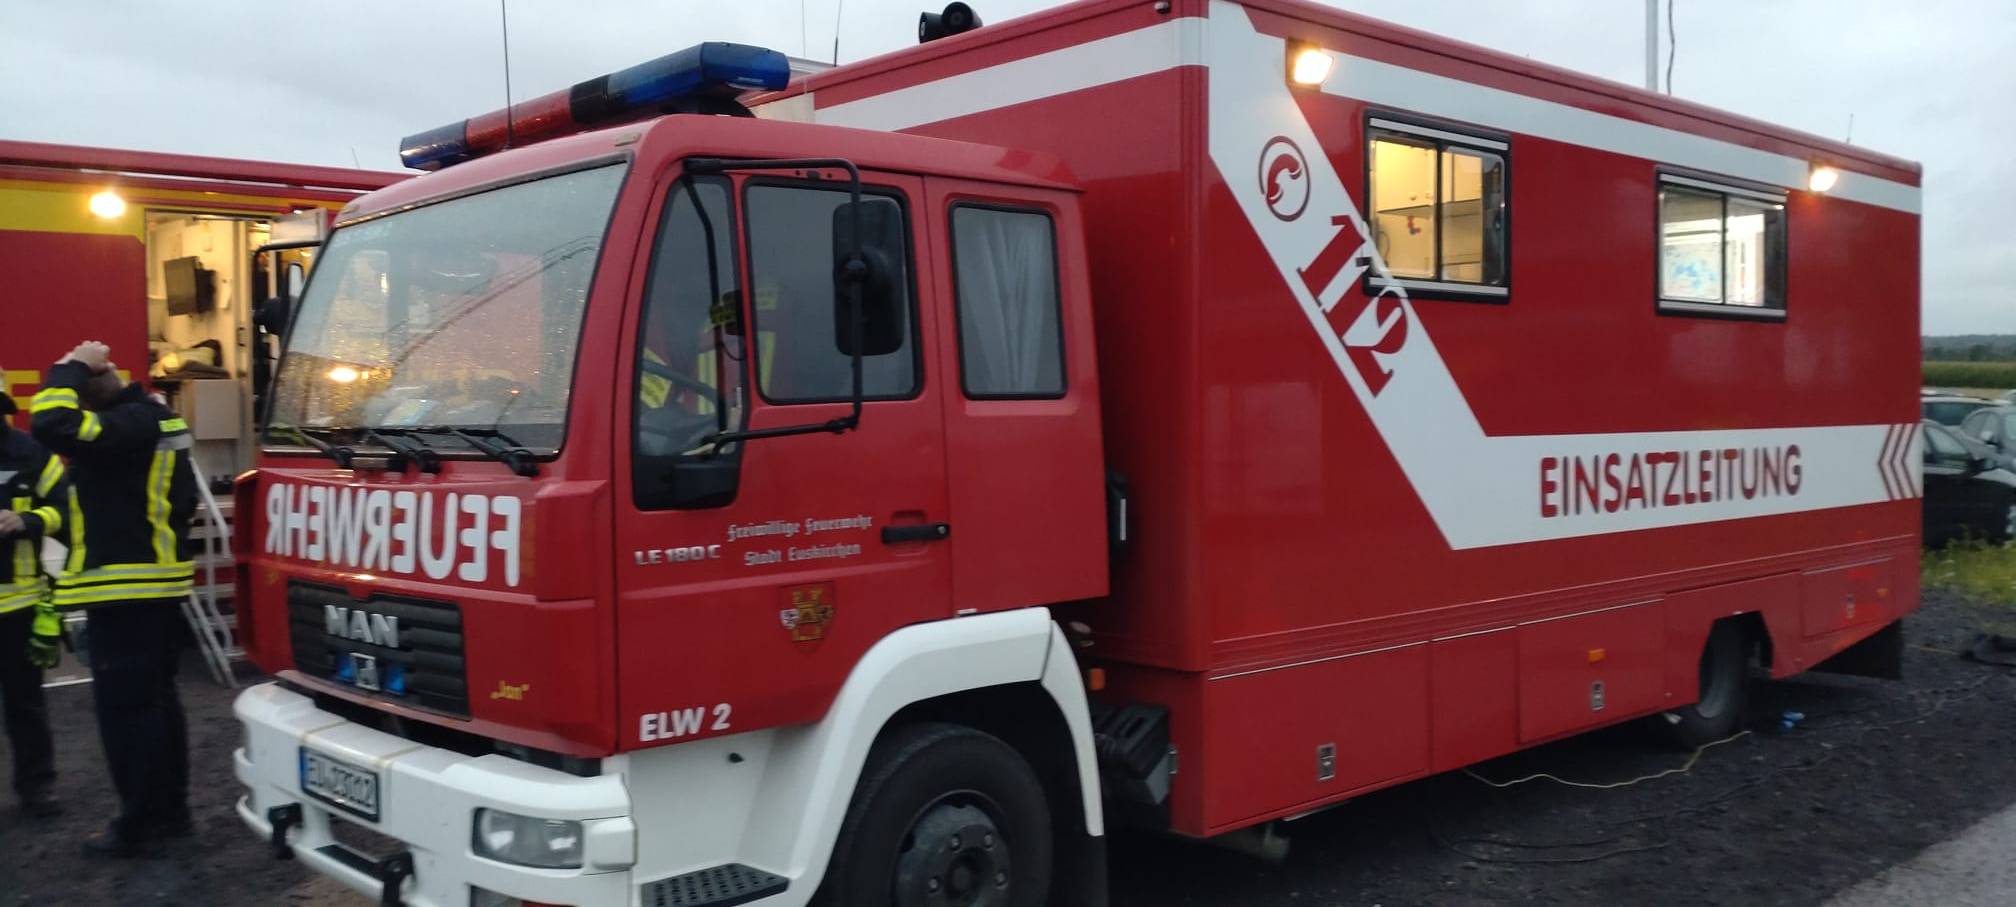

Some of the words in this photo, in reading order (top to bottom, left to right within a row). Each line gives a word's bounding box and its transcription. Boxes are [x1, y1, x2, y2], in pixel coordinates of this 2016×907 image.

[1296, 215, 1408, 398] 112
[1539, 443, 1803, 518] EINSATZLEITUNG
[727, 519, 801, 543] Freiwillige
[804, 514, 874, 537] Feuerwehr
[634, 548, 663, 566] LE
[707, 544, 723, 560] C
[743, 548, 782, 567] Stadt
[788, 542, 862, 564] Euskirchen
[323, 604, 400, 648] MAN
[639, 705, 705, 743] ELW
[712, 701, 732, 732] 2
